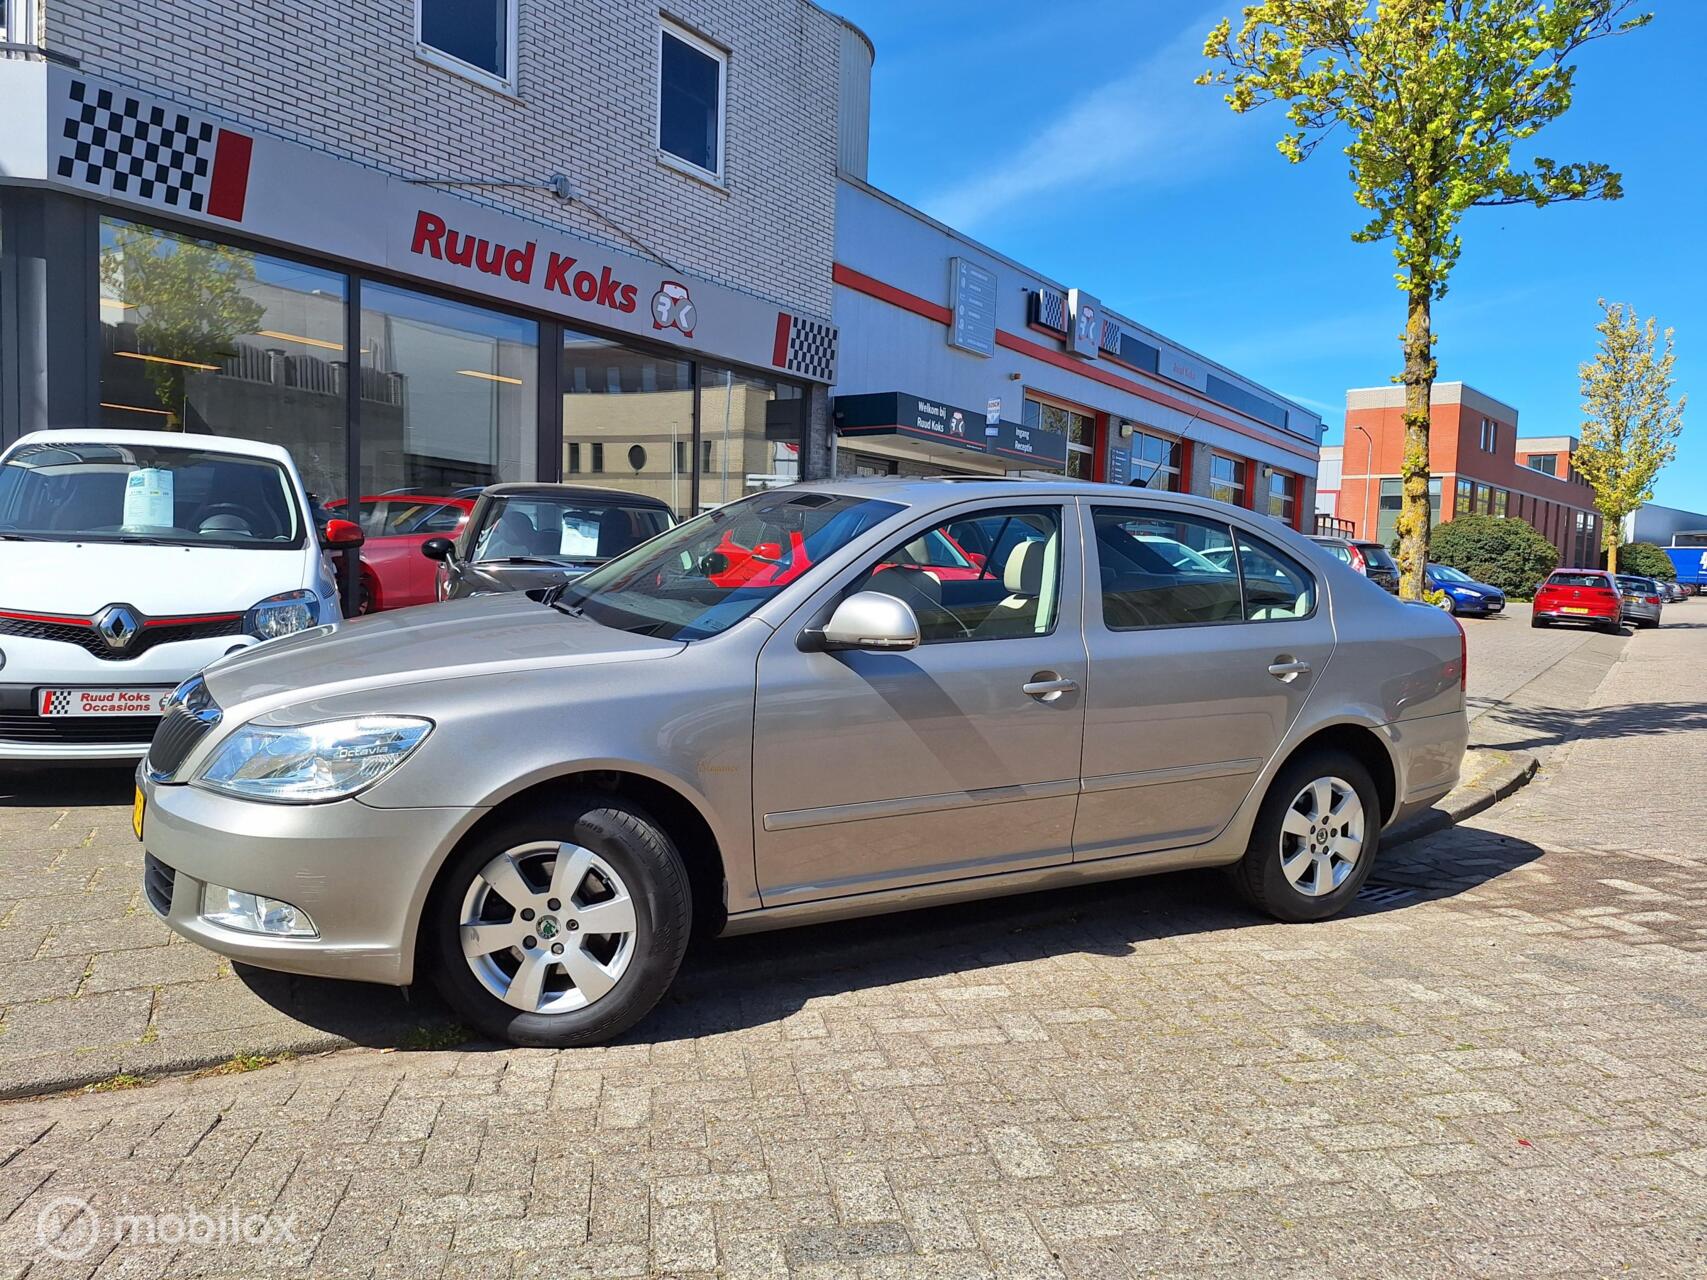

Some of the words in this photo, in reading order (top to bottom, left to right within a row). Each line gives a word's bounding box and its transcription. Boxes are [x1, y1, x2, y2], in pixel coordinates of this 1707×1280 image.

[411, 210, 536, 284] Ruud
[544, 252, 637, 313] Koks
[918, 401, 939, 416] Welkom
[939, 406, 947, 420] bij
[917, 416, 931, 430] Ruud
[931, 420, 944, 433] Koks
[1015, 427, 1030, 441] Ingang
[1014, 440, 1033, 454] Receptie
[80, 692, 114, 702] Ruud
[118, 692, 151, 702] Koks
[82, 703, 151, 712] Occasions
[339, 745, 389, 758] Octavia
